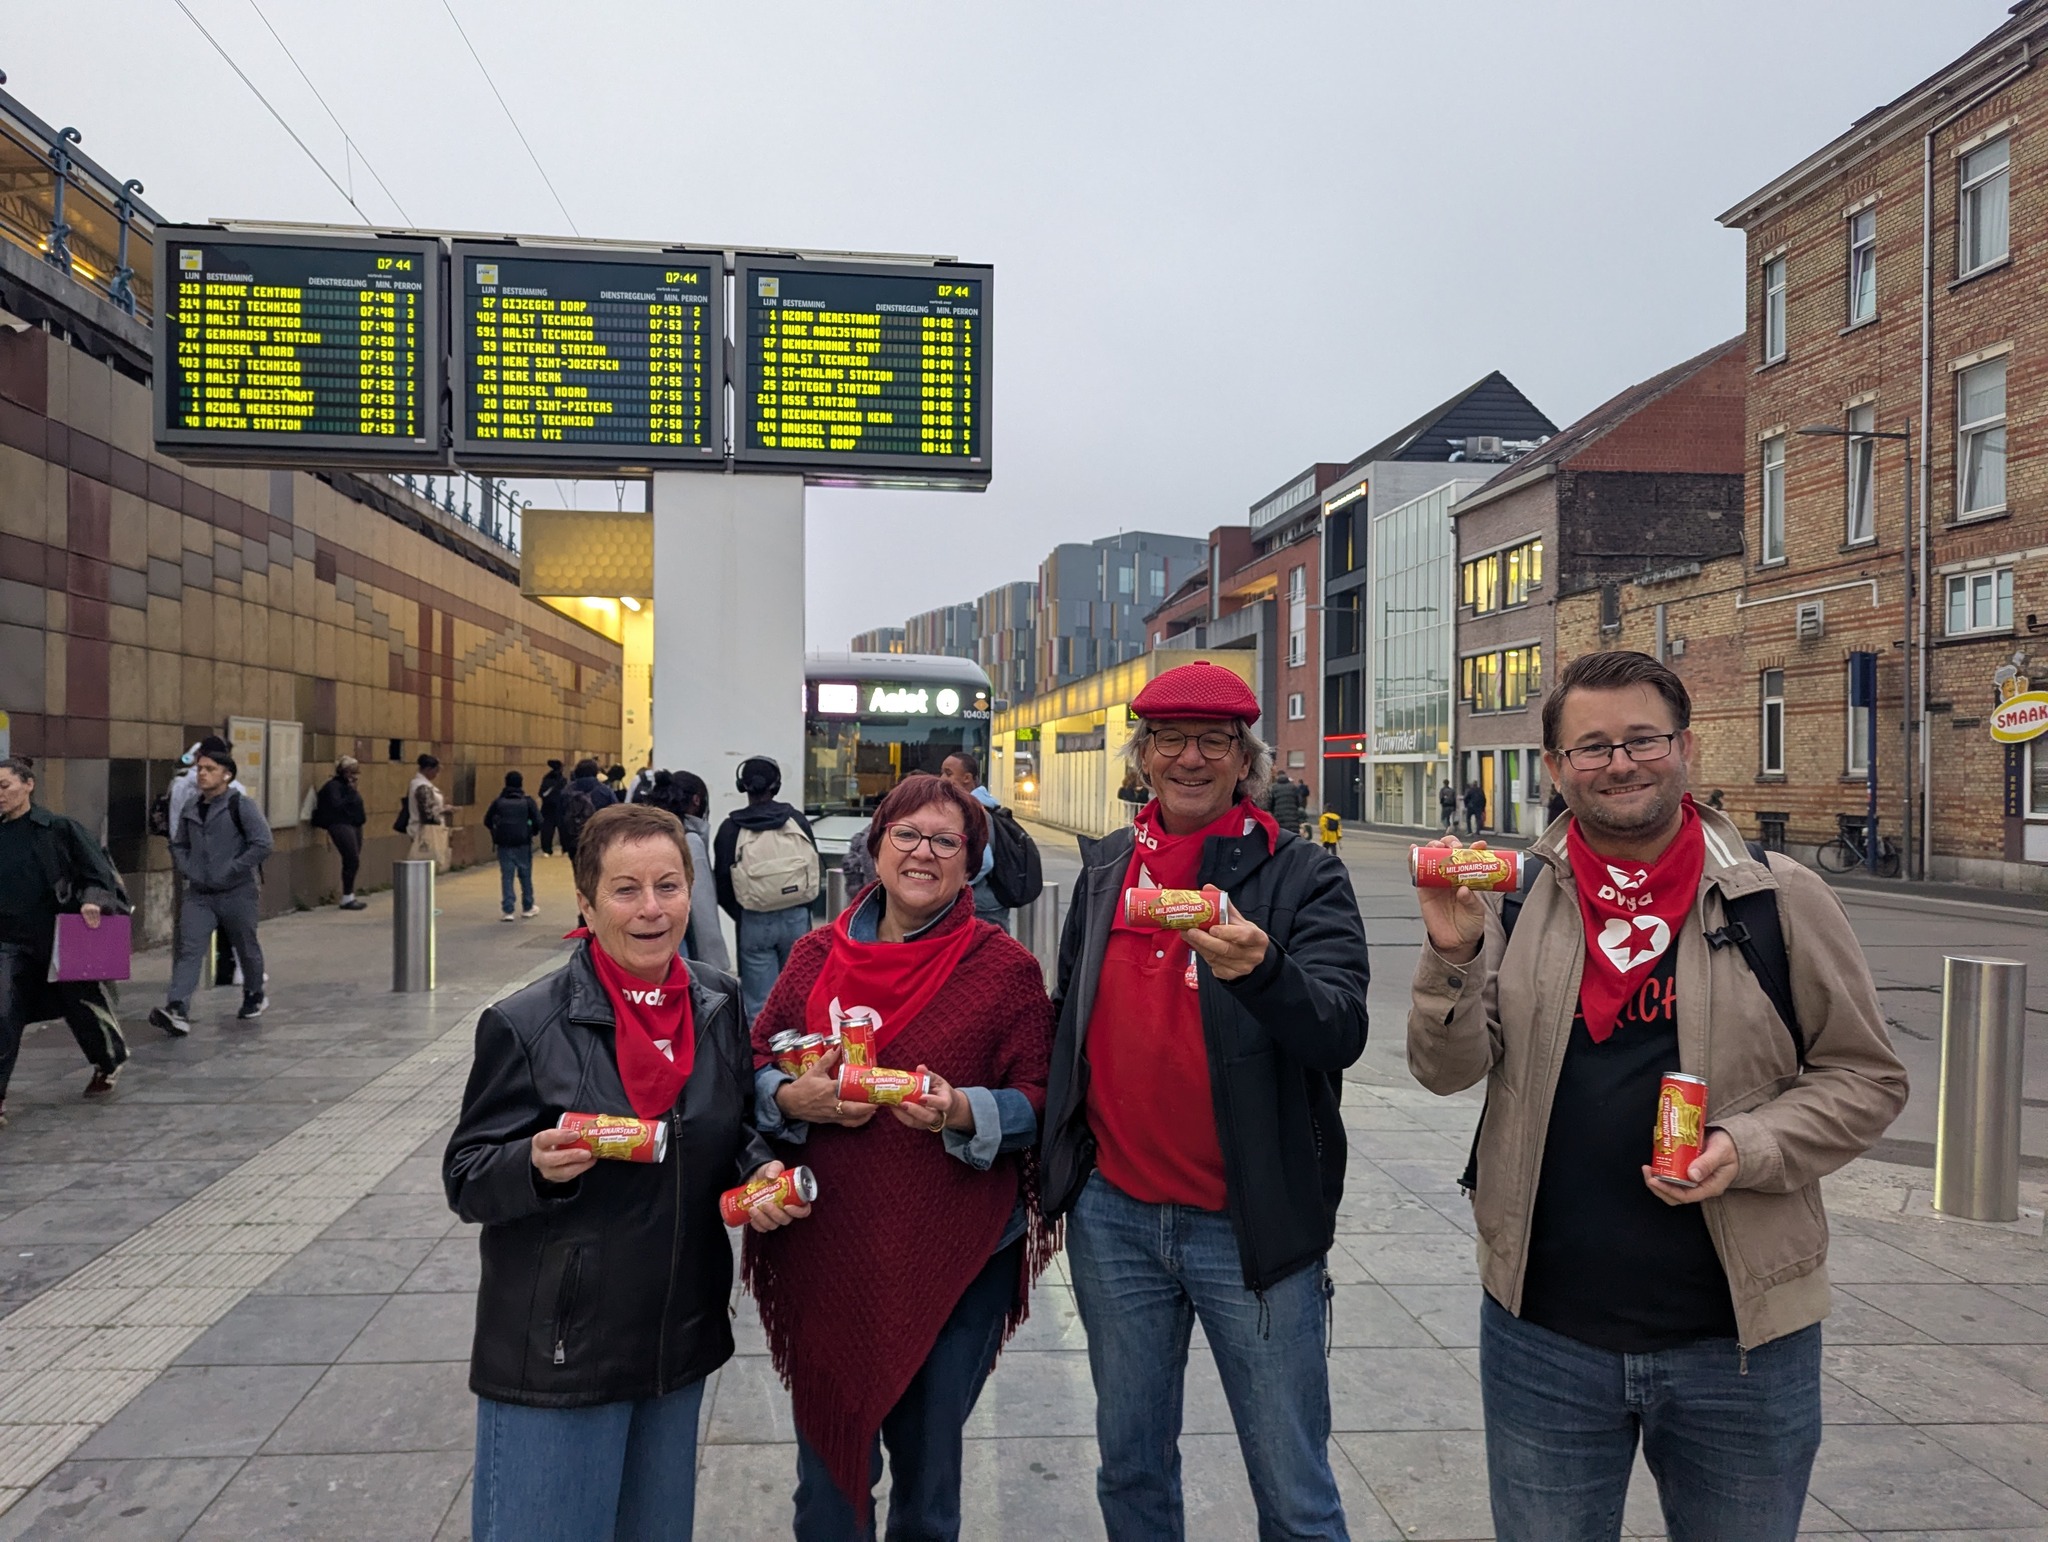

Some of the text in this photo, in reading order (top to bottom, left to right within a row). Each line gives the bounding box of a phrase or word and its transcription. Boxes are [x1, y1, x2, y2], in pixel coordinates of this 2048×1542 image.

[184, 271, 422, 290] LIJN BESTEMMING DIENSTREGELING MIN. PERRON
[179, 282, 201, 295] 313
[205, 283, 247, 297] NINOVE
[359, 290, 395, 304] 07:48
[481, 285, 708, 303] LIJN BESTEMMING DIENSTREGELING MIN. PERRON
[179, 297, 395, 319] 314 AALST TECHNIGO 07:48
[482, 297, 497, 309] 57
[559, 300, 587, 312] DORP
[649, 304, 683, 317] 07:53
[762, 298, 979, 316] LIJN BESTEMMING DIENSTREGELING MIN. PERRON
[178, 311, 395, 333] 913 AALST TECHNIGO 07:48
[476, 311, 683, 331] 402 AALST TECHNIGO 07:53
[781, 309, 815, 323] AZORG
[921, 316, 954, 330] 08:02
[185, 327, 200, 339] 87
[272, 330, 322, 344] STATION
[359, 334, 395, 348] 07:50
[476, 325, 683, 345] 591 AALST TECHNIGO 07:53
[781, 323, 808, 337] OUDE
[921, 330, 954, 343] 08:03
[178, 341, 395, 363] 714 BRUSSEL NOORD 07:50
[482, 340, 498, 352] 59
[560, 343, 607, 357] STATION
[649, 347, 683, 359] 07:54
[763, 337, 777, 349] 57
[855, 341, 881, 354] STAT
[921, 344, 954, 357] 08:03
[178, 356, 395, 377] 403 AALST TECHNIGO 07:51
[476, 354, 498, 367] 804
[649, 361, 683, 373] 07:54
[763, 351, 954, 371] 40 AALST TECHNIGO 08:04
[185, 371, 395, 392] 59 AALST TECHNIGO 07:52
[483, 369, 497, 381] 25
[649, 375, 682, 387] 07:55
[762, 365, 777, 378] 91
[849, 369, 894, 382] STATION
[921, 372, 954, 385] 08:04
[205, 386, 233, 400] OUDE
[360, 392, 396, 406] 07:53
[502, 383, 683, 402] BRUSSEL NOORD 07:55
[762, 379, 954, 399] 25 ZOTTEGEM STATION 08:05
[205, 401, 241, 415] AZORG
[360, 407, 396, 421] 07:53
[483, 397, 683, 416] 20 GENT SINT-PIETERS 07:58
[757, 393, 954, 413] 213 ASSE STATION 08:05
[185, 415, 396, 435] 40 OPWIJK STATION 07:53
[477, 412, 683, 430] 404 AALST TECHNIGO 07:58
[762, 407, 777, 420] 80
[921, 413, 954, 427] 08:06
[502, 427, 683, 444] AALST VTI 07:58
[780, 421, 954, 441] BRUSSEL NOORD 08:10
[762, 435, 777, 447] 40
[829, 437, 857, 450] DORP
[921, 441, 953, 455] 08:11
[962, 709, 990, 720] 104030
[1997, 705, 2048, 729] SMAAK
[1374, 730, 1418, 752] Lijnwinkel
